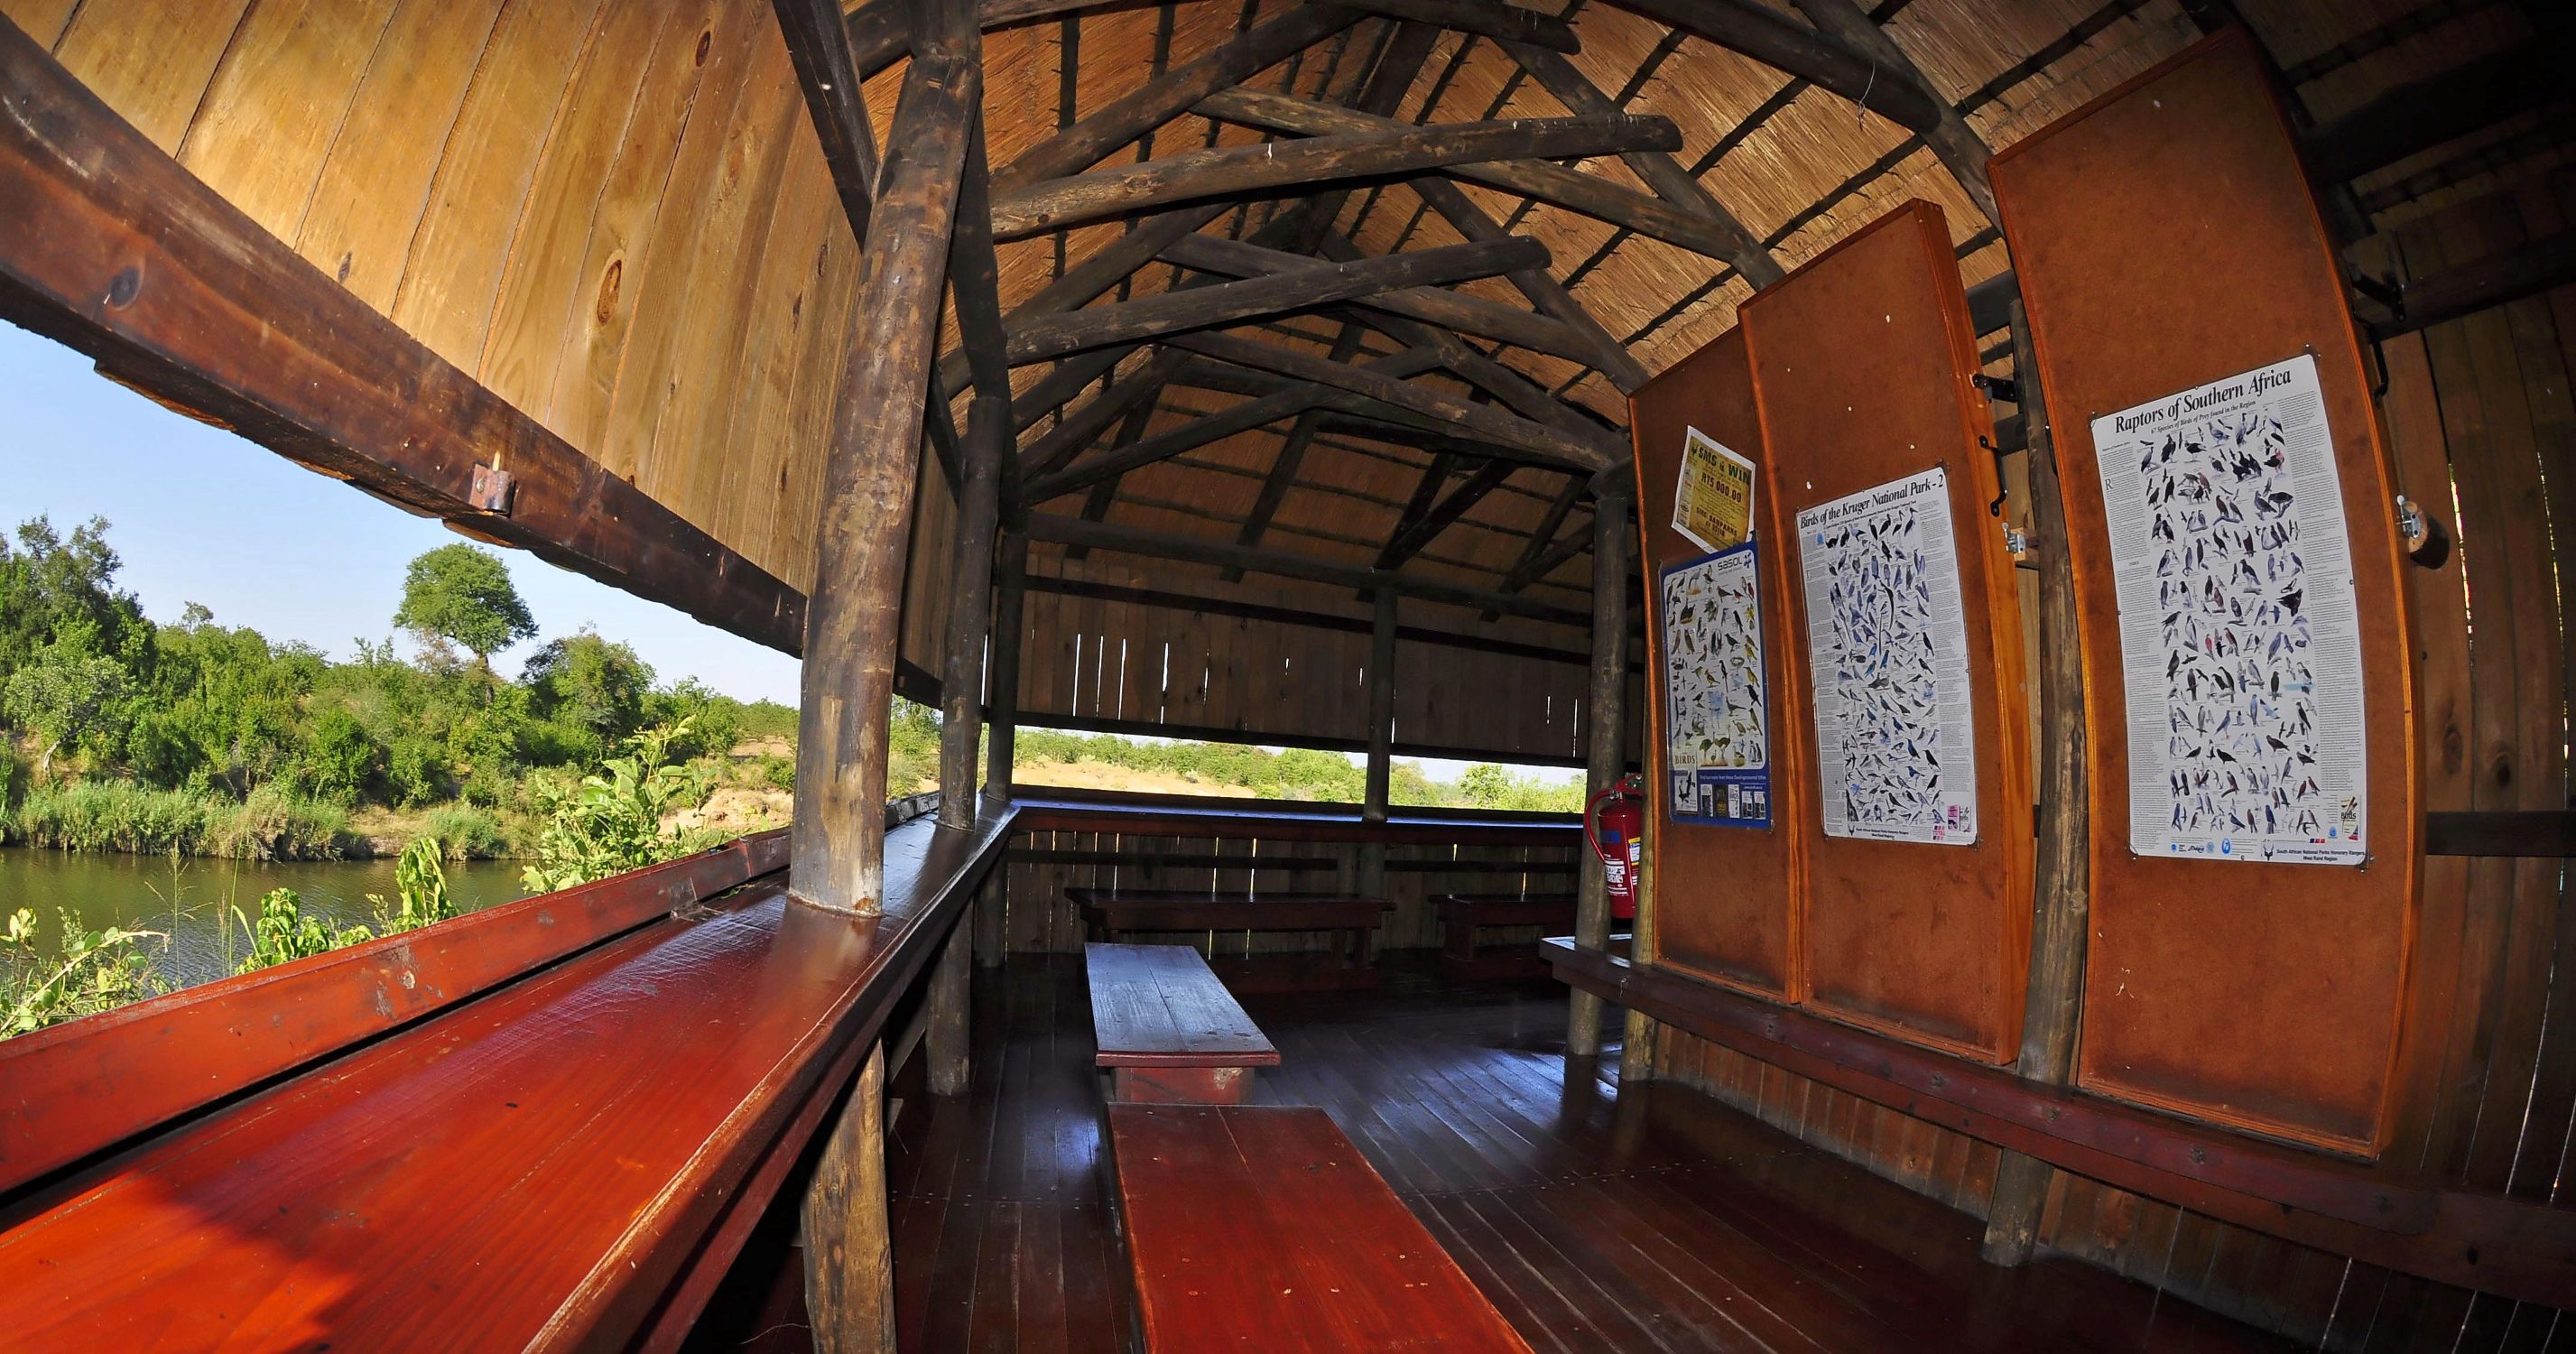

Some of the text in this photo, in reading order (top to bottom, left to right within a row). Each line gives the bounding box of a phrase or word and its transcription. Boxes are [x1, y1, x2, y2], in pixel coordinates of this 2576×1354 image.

[2115, 368, 2291, 433] Raptors of Southern Africa
[2157, 423, 2174, 433] Species
[2174, 422, 2181, 430] of
[2199, 413, 2210, 421] Prey
[2210, 407, 2224, 418] found
[2239, 400, 2256, 410] Region
[1698, 447, 1717, 466] SMS
[1728, 464, 1751, 485] WIN
[1701, 472, 1714, 488] R75
[1801, 514, 1819, 529] Birds
[1820, 508, 1830, 524] of
[1829, 506, 1841, 520] the
[1842, 499, 1870, 515] Kruger
[1872, 486, 1908, 507] National
[1910, 478, 1931, 496] Park
[1938, 474, 1943, 487] 2
[1675, 755, 1696, 765] BIRDS
